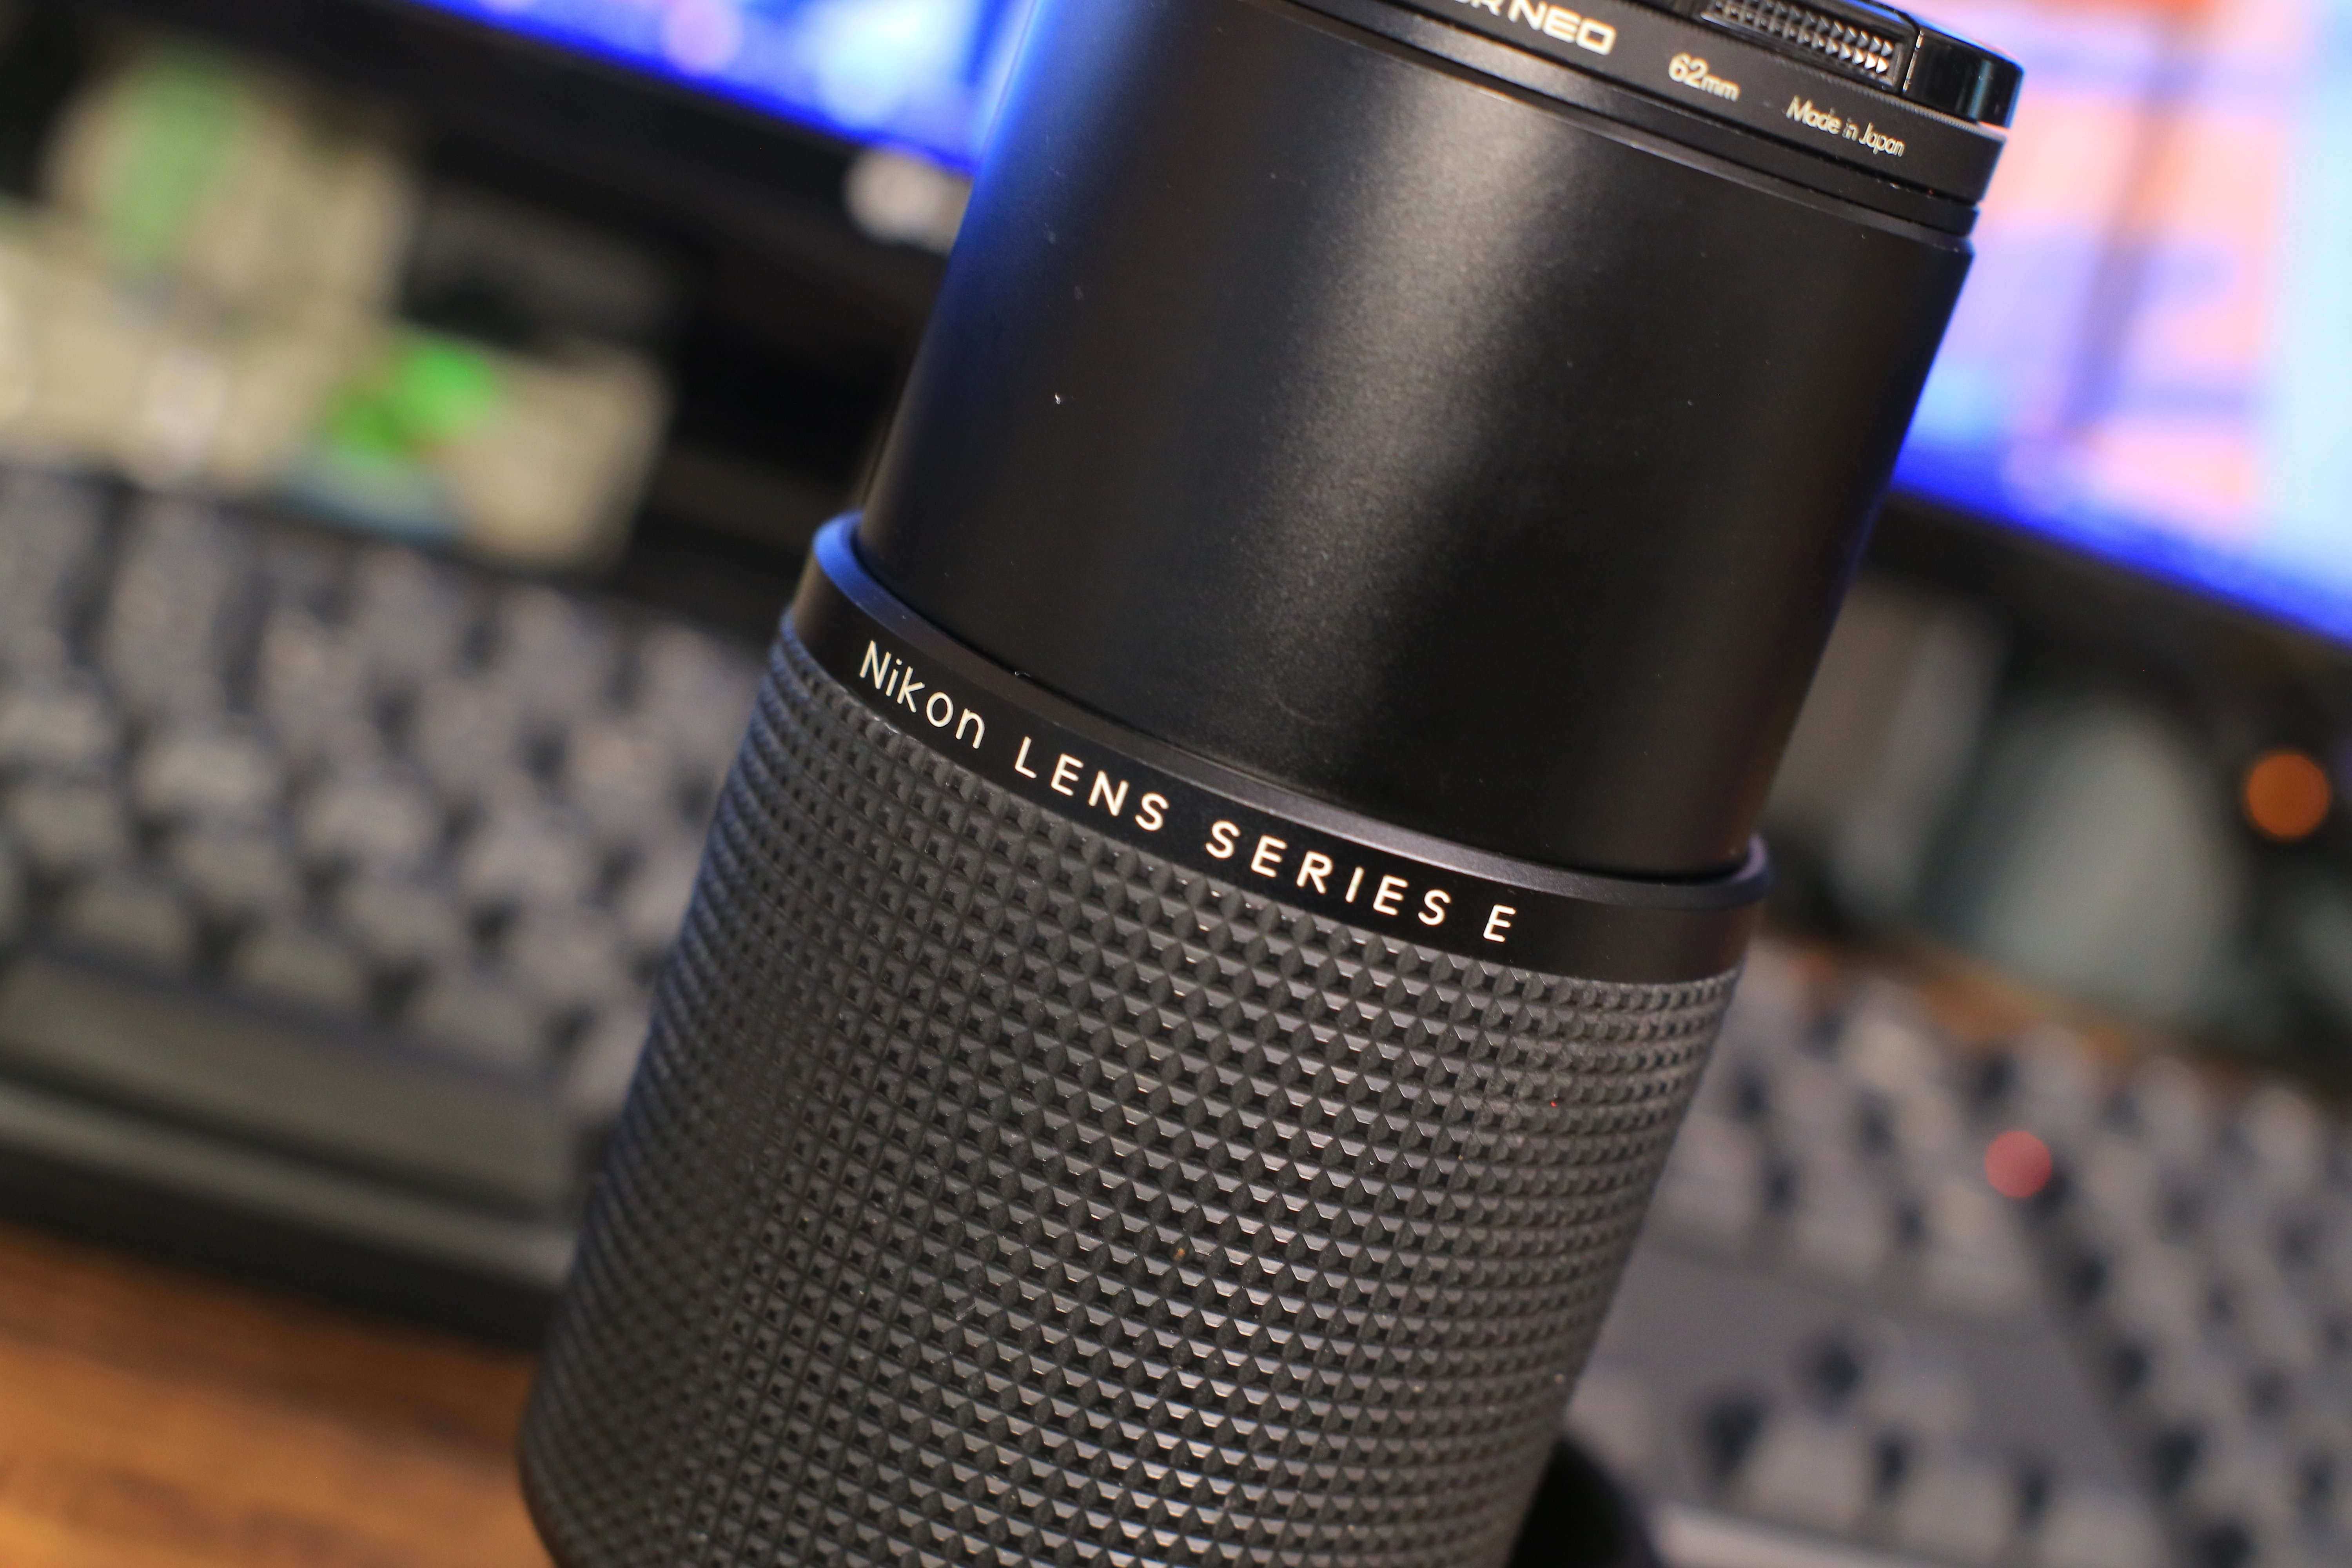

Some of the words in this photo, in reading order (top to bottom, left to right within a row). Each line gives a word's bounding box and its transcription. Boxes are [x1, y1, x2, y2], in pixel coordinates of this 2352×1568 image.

[1508, 0, 1617, 55] NEO
[1668, 53, 1741, 102] 62mm
[1786, 95, 1842, 134] Made
[1842, 117, 1860, 141] in
[1858, 122, 1906, 158] Japan
[859, 640, 985, 749] Nikon
[1014, 736, 1169, 831] LENS
[1205, 820, 1451, 926] SERIES
[1483, 904, 1516, 942] E
